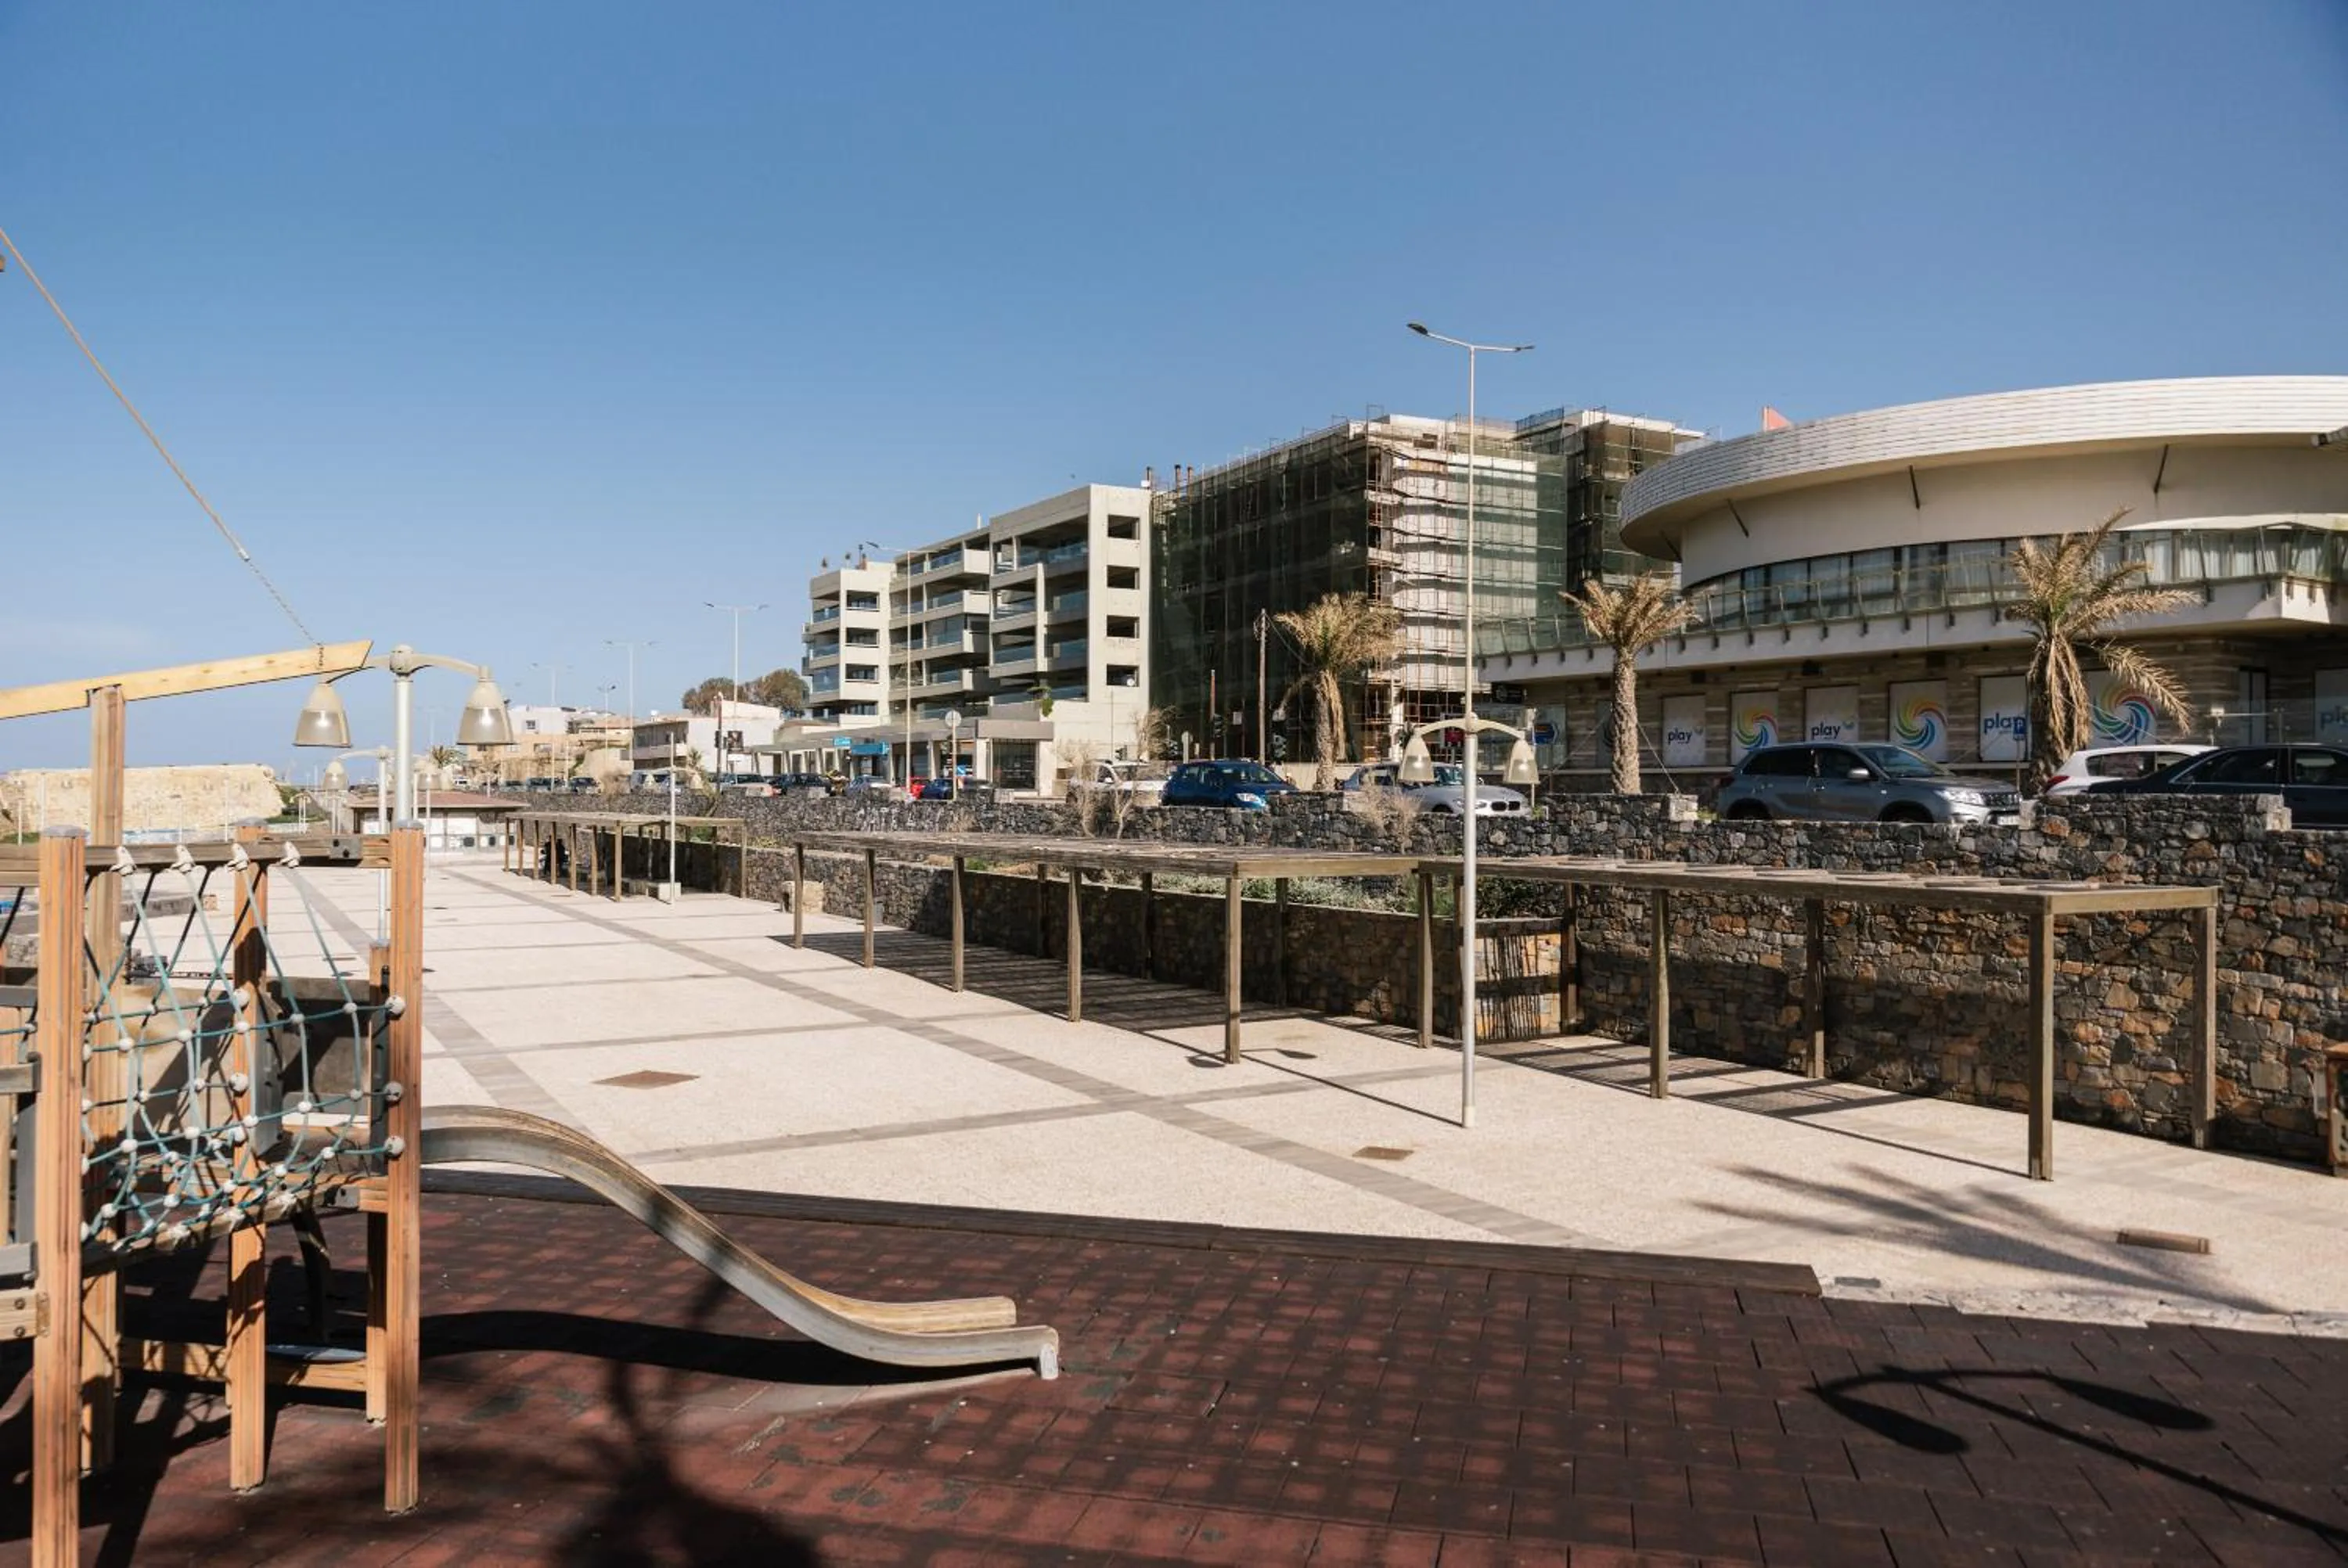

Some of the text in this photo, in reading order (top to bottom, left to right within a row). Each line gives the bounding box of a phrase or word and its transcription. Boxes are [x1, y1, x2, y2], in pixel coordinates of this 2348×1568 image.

[1811, 721, 1841, 740] play
[1984, 712, 2015, 735] pla
[1668, 727, 1692, 745] play
